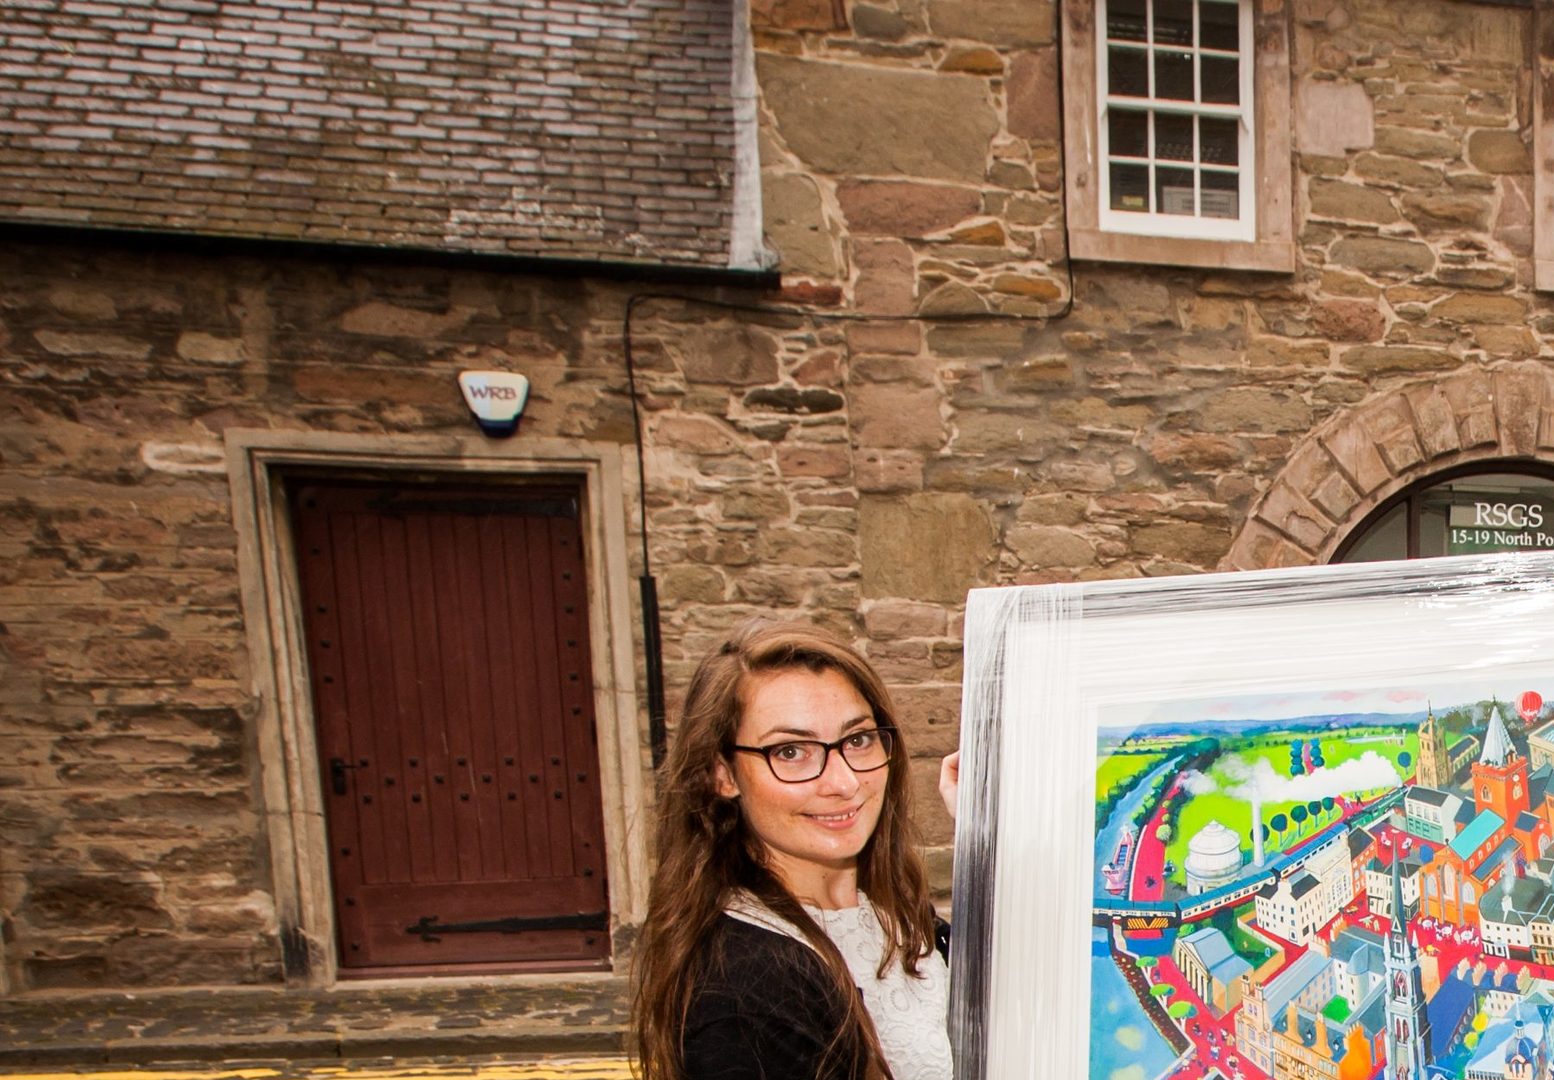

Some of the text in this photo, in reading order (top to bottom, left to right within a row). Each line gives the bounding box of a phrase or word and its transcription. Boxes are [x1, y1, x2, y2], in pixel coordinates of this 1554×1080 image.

[470, 385, 517, 400] WRB
[1474, 502, 1544, 528] RSGS
[1451, 529, 1491, 545] 15-19
[1494, 531, 1533, 546] North
